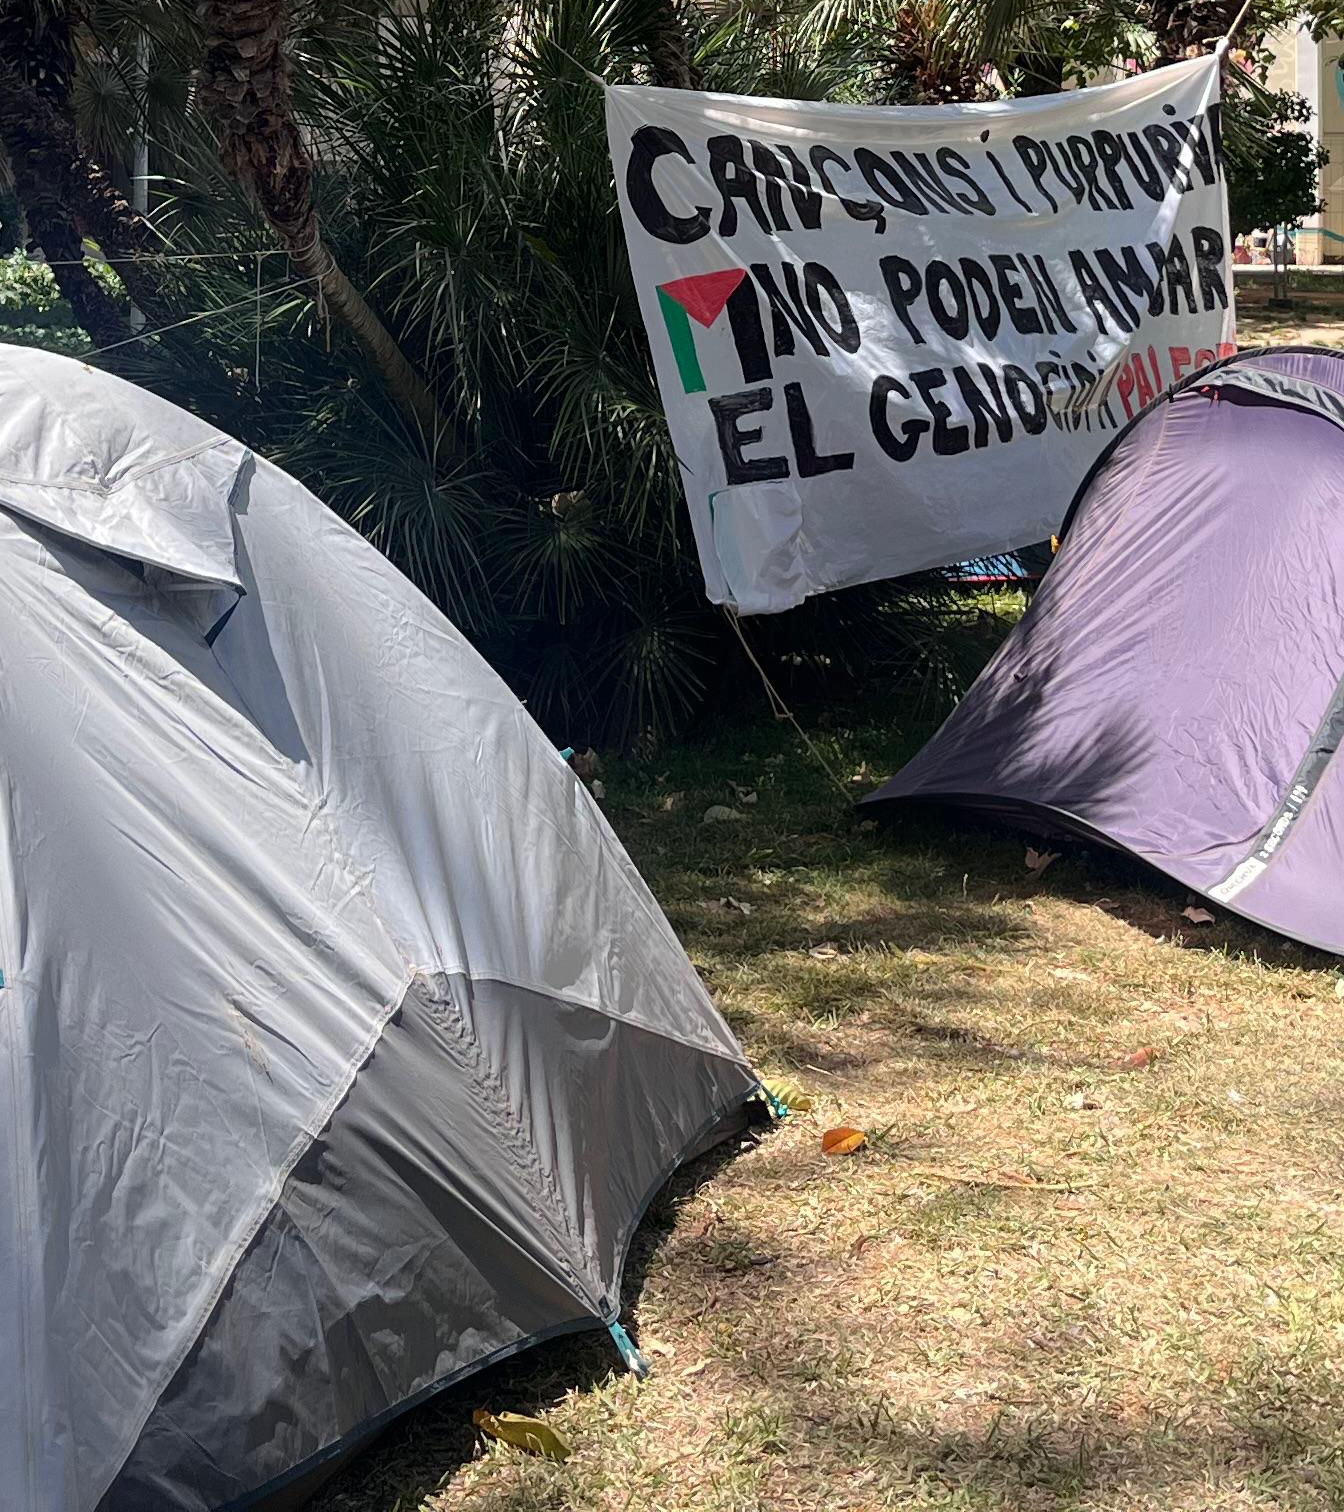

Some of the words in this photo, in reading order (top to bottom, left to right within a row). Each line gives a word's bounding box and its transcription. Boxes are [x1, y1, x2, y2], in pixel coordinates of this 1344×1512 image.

[626, 125, 996, 244] CANÇONS
[754, 261, 862, 356] NO
[878, 251, 1078, 345] PODEN
[708, 382, 854, 486] EL
